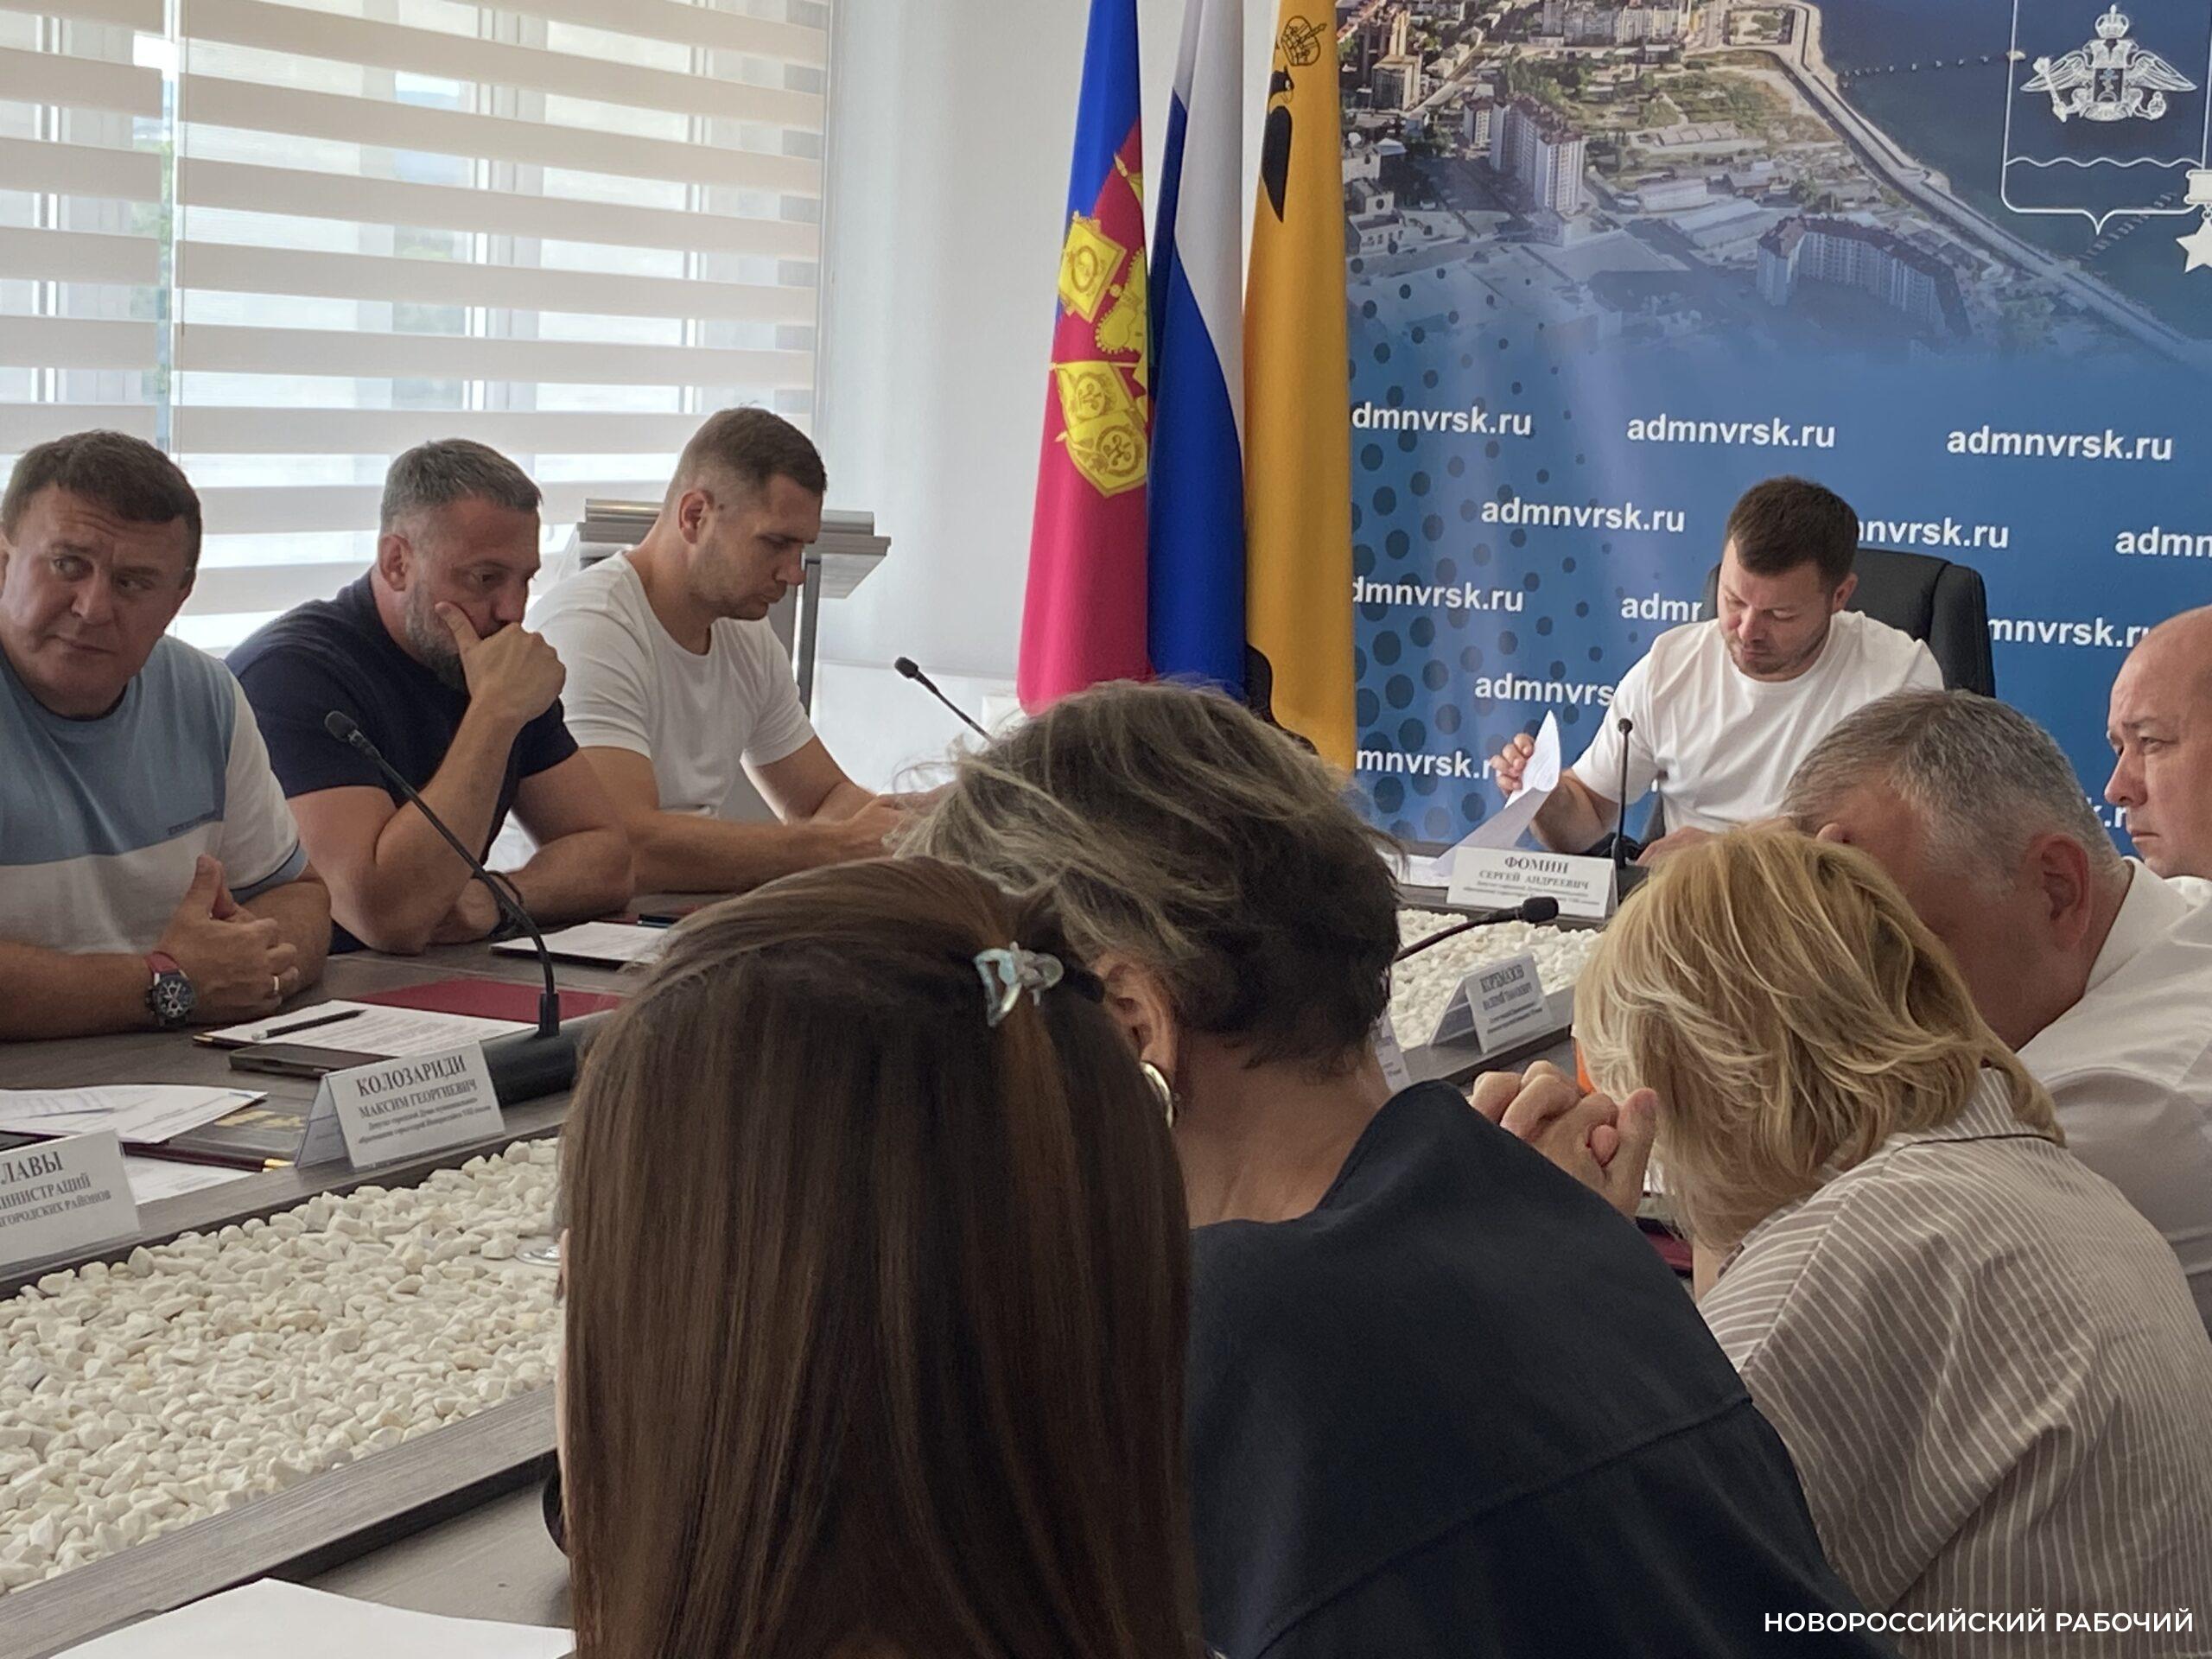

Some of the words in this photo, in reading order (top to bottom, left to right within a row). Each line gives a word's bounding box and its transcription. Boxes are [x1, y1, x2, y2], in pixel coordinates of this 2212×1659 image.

[1352, 402, 1531, 435] dmnvrsk.ru
[1627, 413, 1835, 448] admnvrsk.ru
[1947, 425, 2172, 461] admnvrsk.ru
[1481, 497, 1685, 532] admnvrsk.ru
[1858, 517, 2009, 549] nvrsk.ru
[1352, 575, 1524, 612] dmnvrsk.ru
[1987, 617, 2150, 648] mnvrsk.r
[1474, 673, 1614, 707] admnvrs
[1356, 749, 1491, 779] mnvrsk.r
[1479, 870, 1521, 883] СЕРГЕЙ
[1524, 875, 1590, 890] АНДРЕЕВИЧ
[1504, 856, 1569, 874] ФОМИН
[355, 1054, 467, 1097] КОЛОЗАРИДИ
[358, 1096, 410, 1120] МАКСИМ
[410, 1079, 478, 1109] ГЕОРГИЕВИЧ
[0, 1151, 64, 1185] ЛАВЫ
[0, 1172, 92, 1210] ИНИСТРАЦИЙ
[0, 1202, 64, 1228] ГОРОДСКИХ
[64, 1190, 111, 1211] РАЙОНОВ
